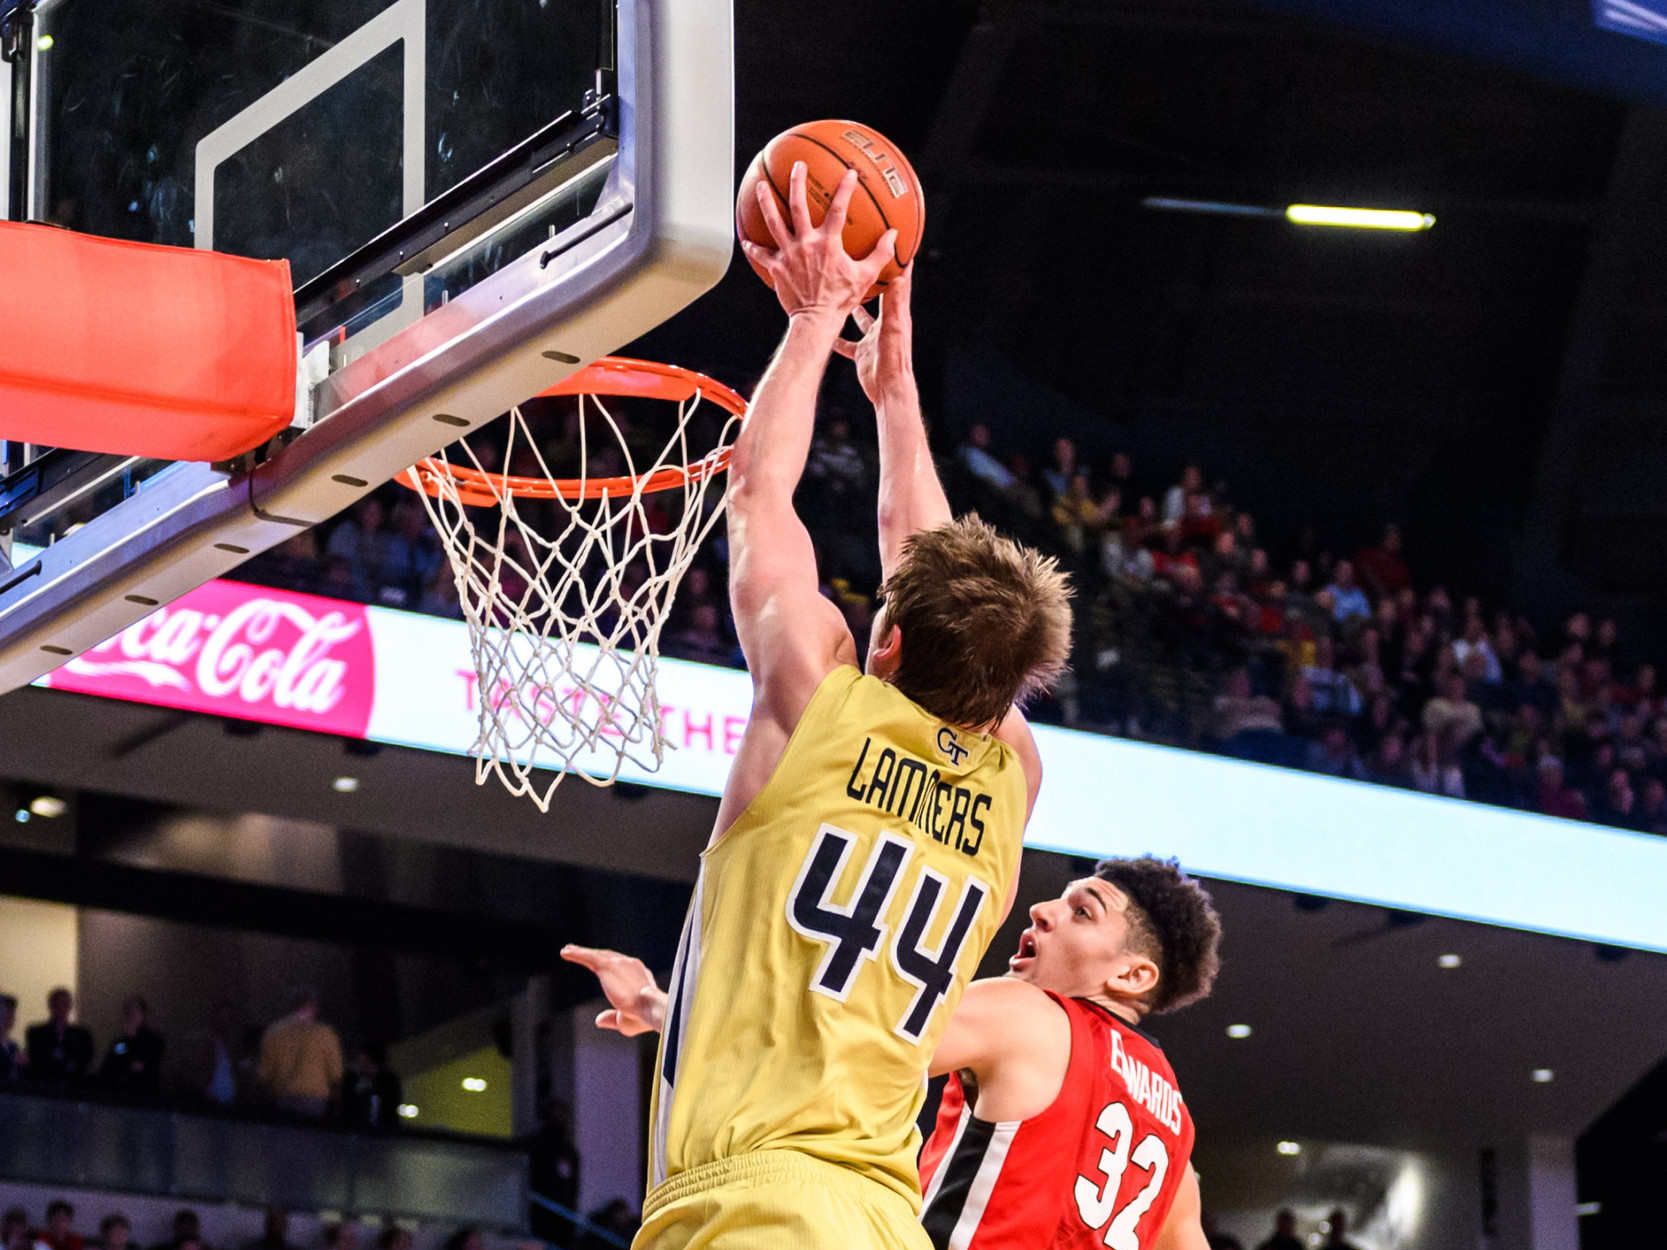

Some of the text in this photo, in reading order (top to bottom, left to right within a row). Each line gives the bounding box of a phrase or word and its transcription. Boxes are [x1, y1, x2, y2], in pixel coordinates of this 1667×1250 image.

[64, 598, 362, 713] ca-Cola
[650, 700, 747, 755] THE
[936, 727, 969, 766] GT
[846, 737, 993, 857] LAMMERS
[785, 822, 991, 1047] 44
[1110, 1028, 1184, 1136] EWARDS
